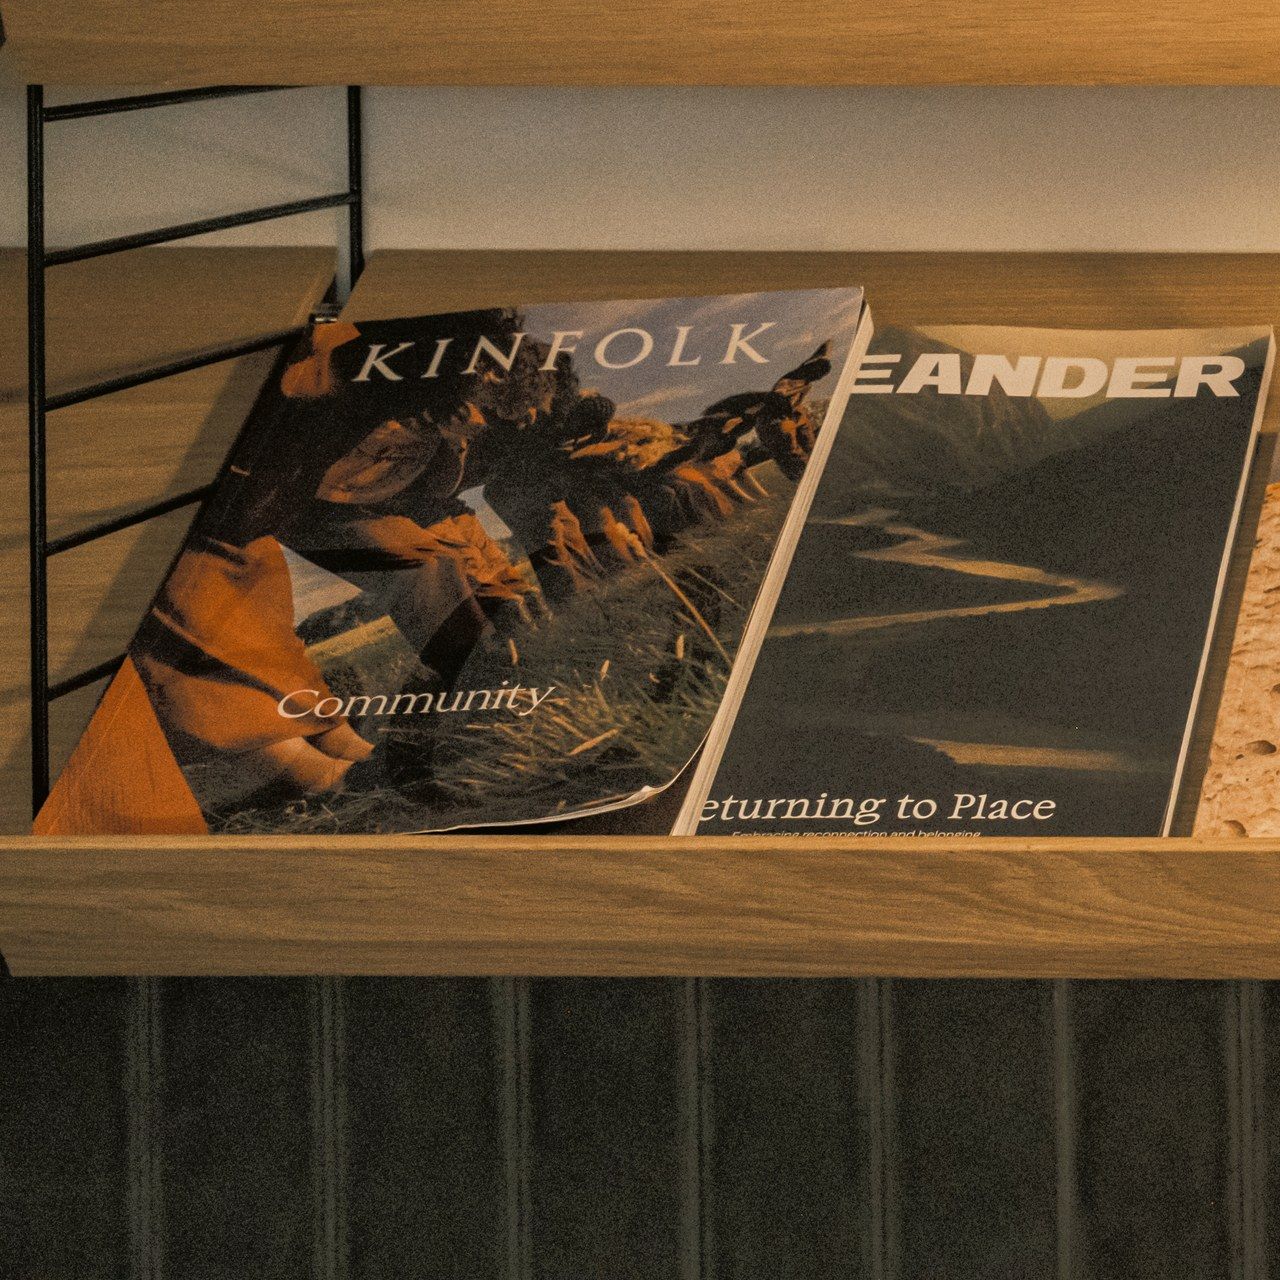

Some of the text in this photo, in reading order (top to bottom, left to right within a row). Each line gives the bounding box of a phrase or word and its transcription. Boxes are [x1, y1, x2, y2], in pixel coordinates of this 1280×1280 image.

[352, 321, 778, 382] KINFOLK
[850, 353, 1246, 398] EANDER
[277, 680, 556, 718] Community
[699, 791, 1057, 826] eturning to Place
